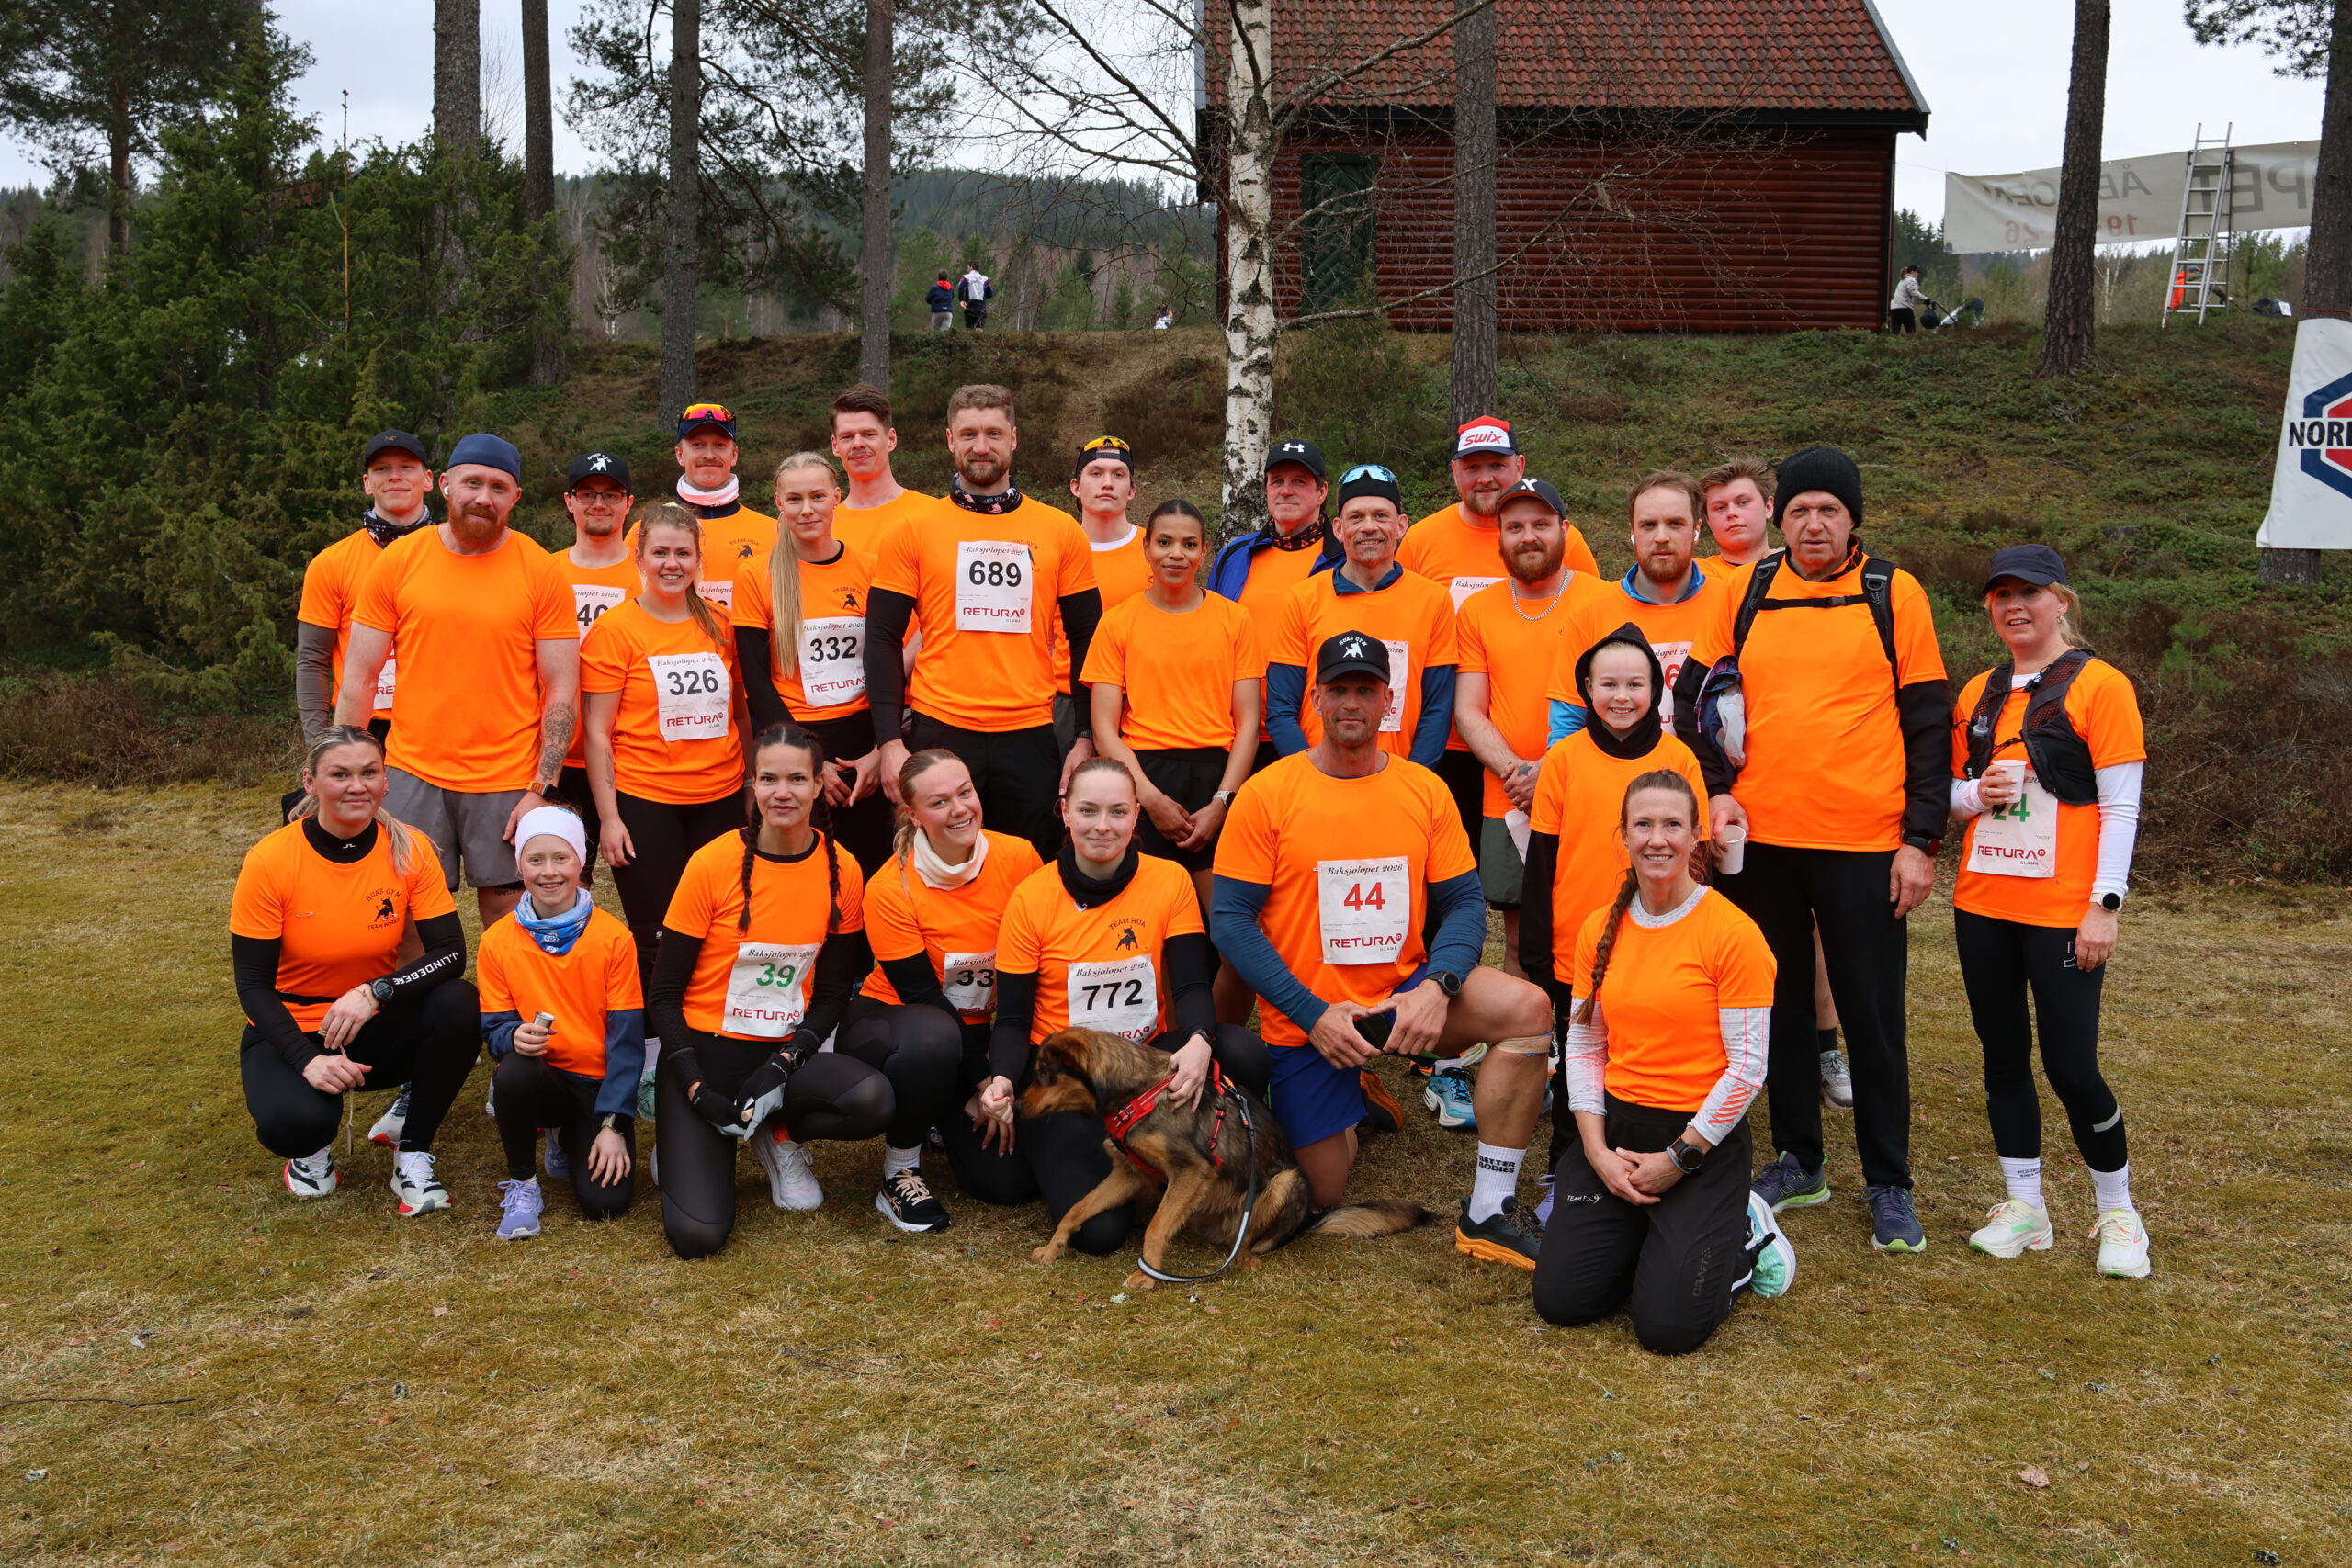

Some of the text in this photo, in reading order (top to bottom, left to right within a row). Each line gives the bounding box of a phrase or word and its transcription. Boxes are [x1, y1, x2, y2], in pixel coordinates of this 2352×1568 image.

[969, 560, 1022, 587] 689
[963, 607, 1021, 618] RETURA
[809, 636, 858, 662] 332
[667, 669, 718, 695] 326
[811, 678, 865, 694] RETURA
[667, 715, 720, 727] RETURA
[1977, 845, 2039, 860] RETURA
[1382, 863, 1403, 872] 2026
[386, 887, 401, 898] GYM
[1343, 882, 1386, 911] 44
[1108, 918, 1146, 931] TEAM HUA
[1329, 935, 1396, 948] RETURA
[1130, 962, 1148, 971] 2026
[756, 962, 796, 988] 39
[1082, 979, 1143, 1010] 772
[732, 1007, 797, 1021] RETURA
[1692, 1257, 1709, 1297] CRAFT
